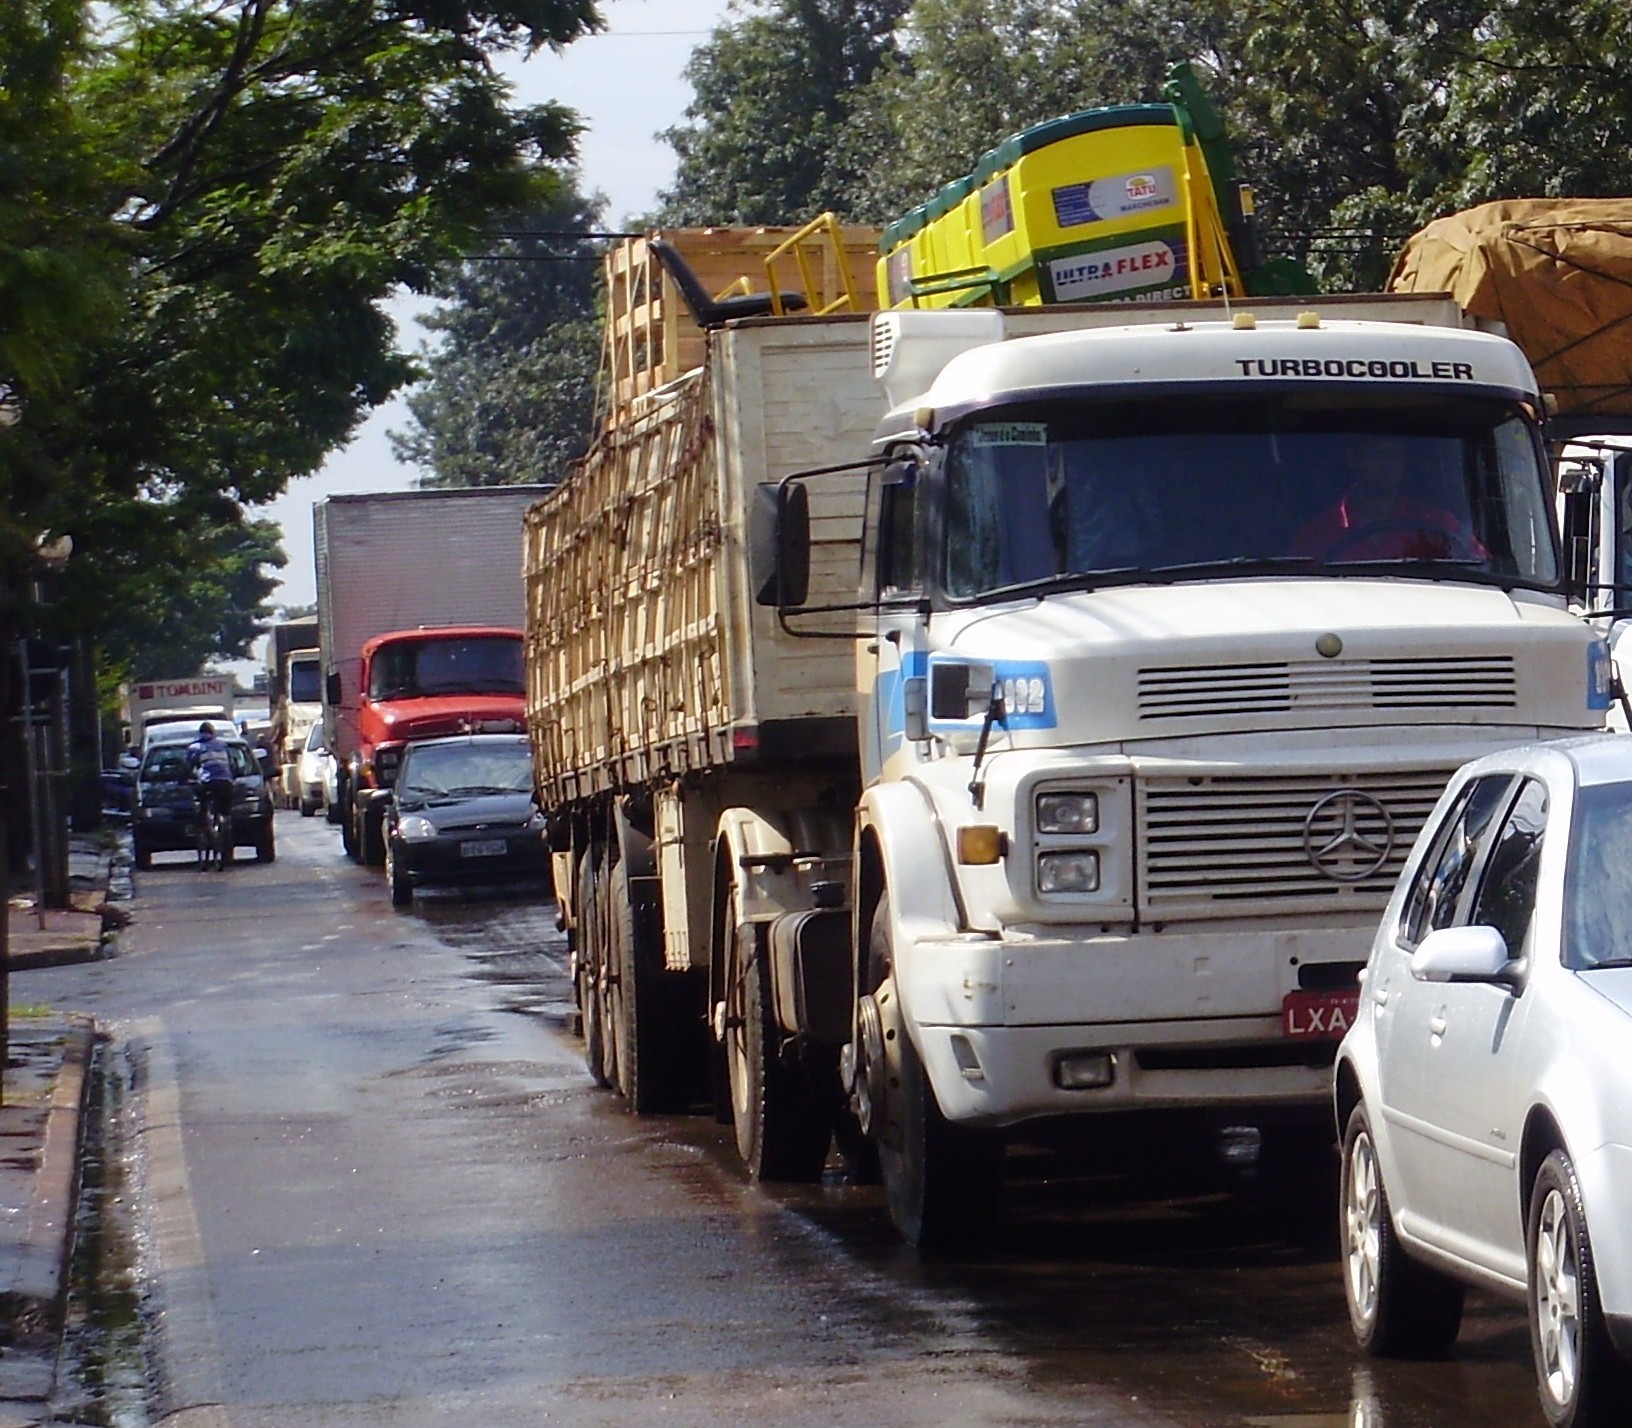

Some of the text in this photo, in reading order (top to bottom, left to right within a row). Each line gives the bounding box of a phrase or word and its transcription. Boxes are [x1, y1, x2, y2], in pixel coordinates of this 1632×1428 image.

[1125, 184, 1156, 197] TATU
[1117, 250, 1169, 275] FLEX
[1235, 359, 1474, 380] TURBOCOOLER
[157, 681, 226, 698] TOMBINI
